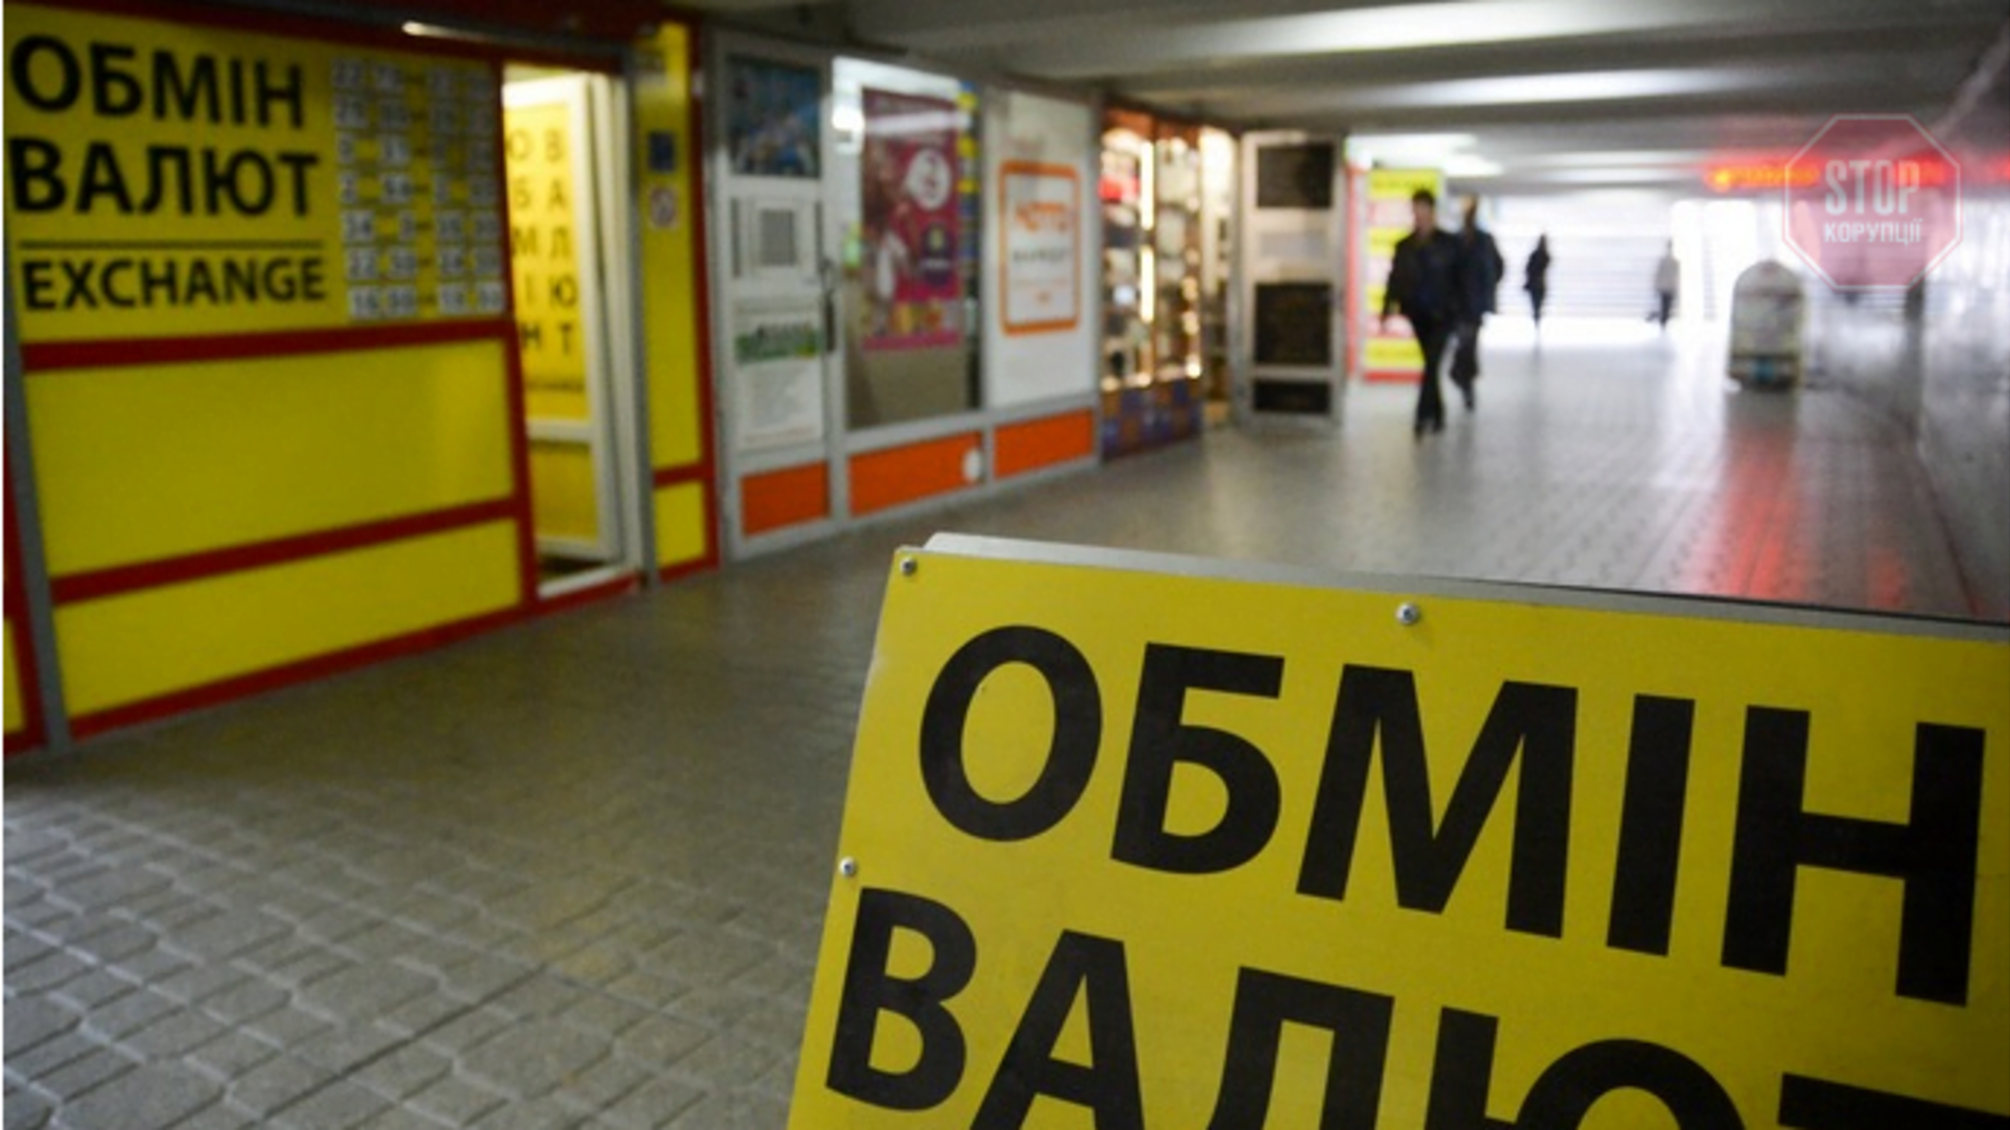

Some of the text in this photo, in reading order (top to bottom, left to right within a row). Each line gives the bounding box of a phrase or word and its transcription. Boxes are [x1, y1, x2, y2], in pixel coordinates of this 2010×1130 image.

[9, 33, 304, 130] ОБМІН
[9, 135, 319, 218] ВАЛЮТ
[22, 256, 325, 311] EXCHANGE
[918, 624, 1986, 1007] ОБМІН
[825, 886, 2010, 1130] ВАЛ
